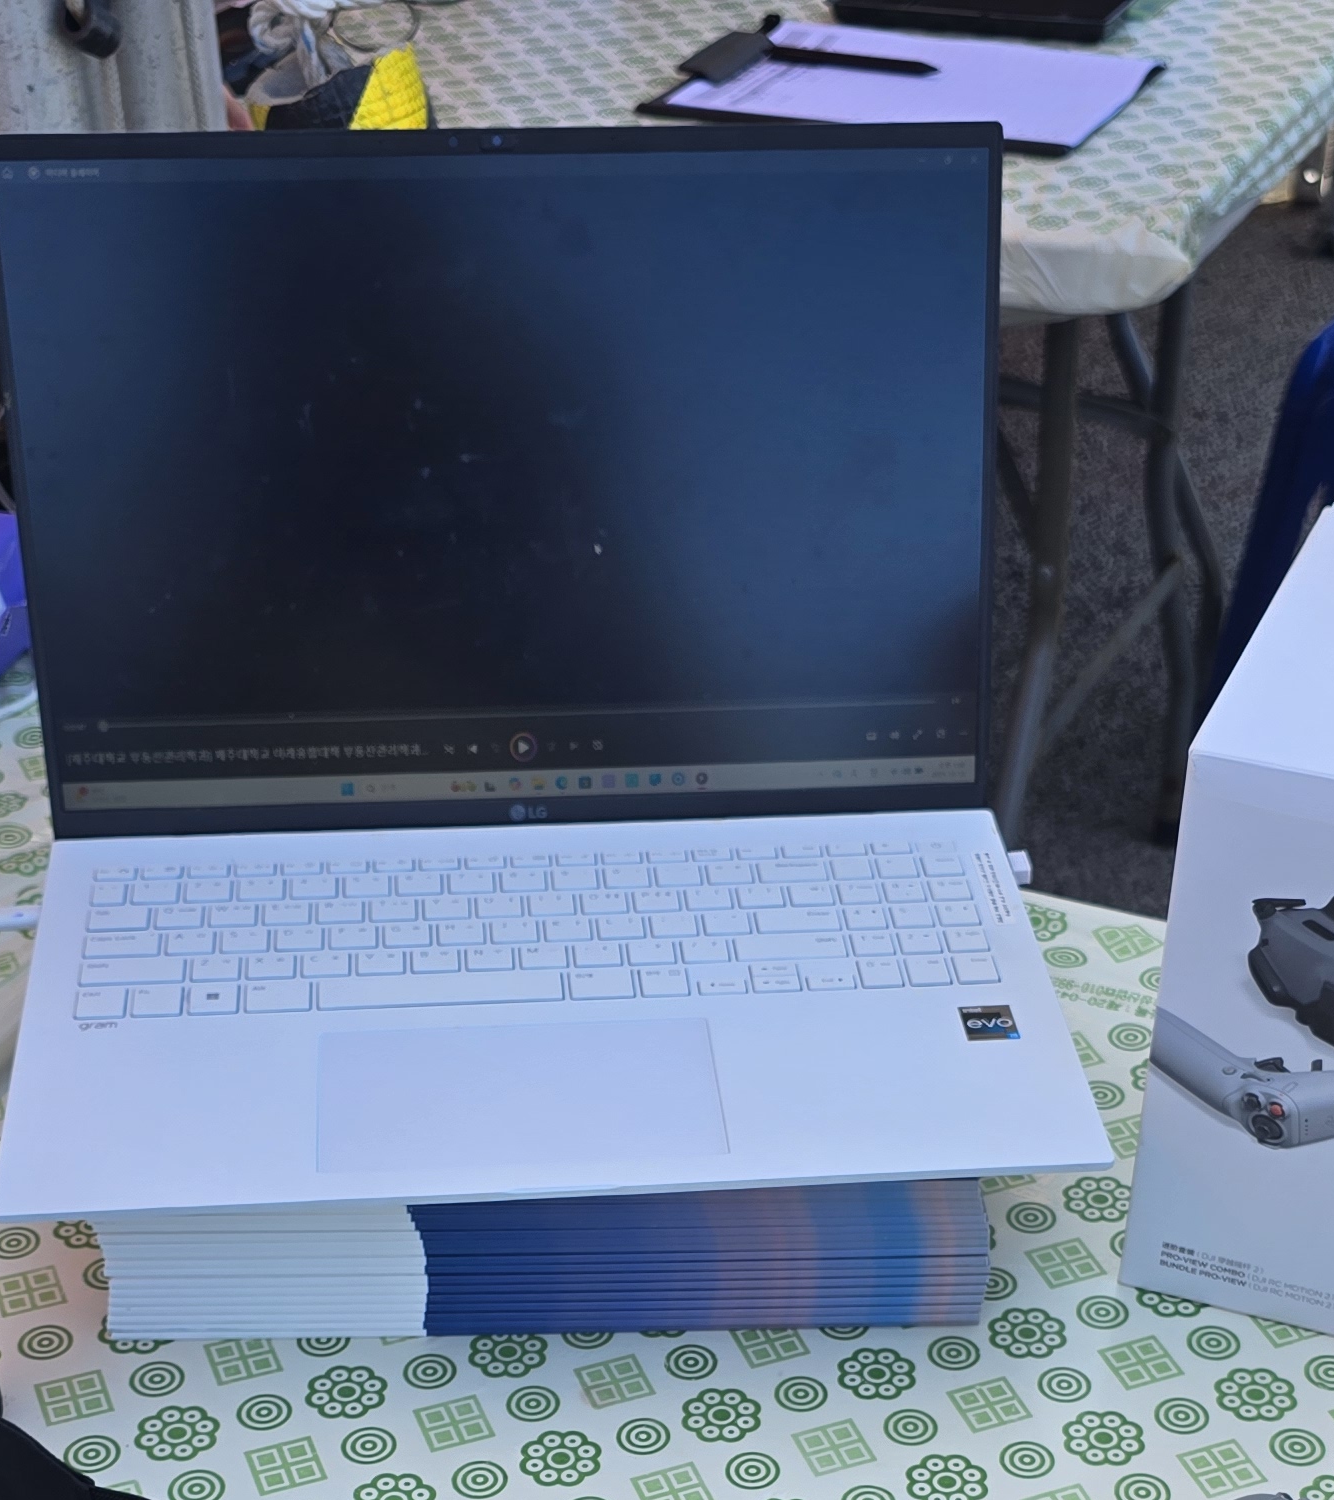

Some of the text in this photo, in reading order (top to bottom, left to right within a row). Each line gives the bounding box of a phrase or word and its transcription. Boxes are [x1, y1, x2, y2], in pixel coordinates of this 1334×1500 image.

[528, 806, 548, 819] LG
[78, 1020, 118, 1032] gram
[967, 1017, 1013, 1029] evo
[1160, 1250, 1208, 1268] PRO-VIEW
[1210, 1264, 1245, 1278] COMBO
[1284, 1282, 1323, 1298] MOTION
[1159, 1259, 1197, 1275] BUNDLE
[1199, 1270, 1247, 1287] PRO-VIEW
[1285, 1291, 1324, 1307] MOTION
